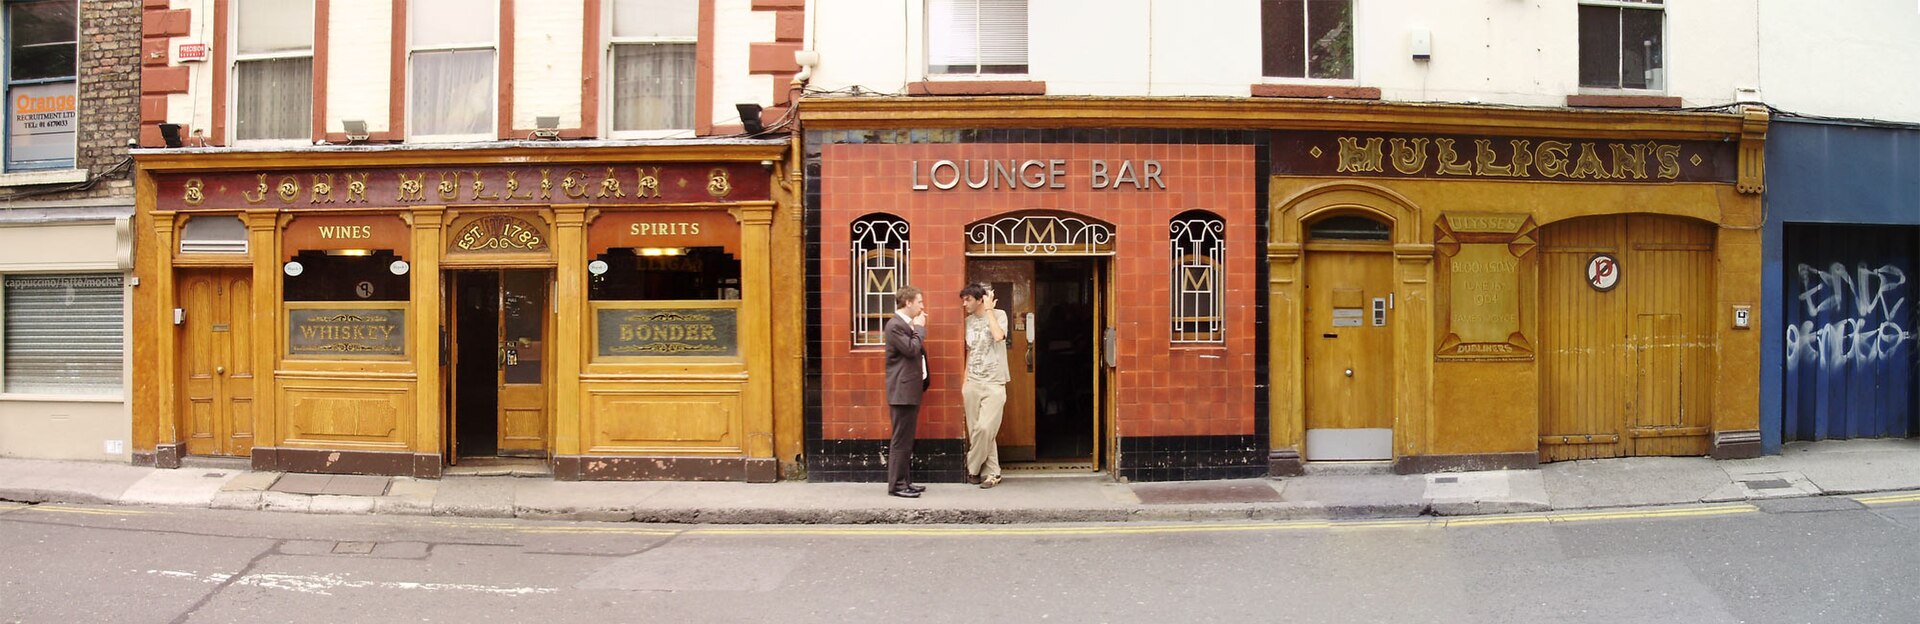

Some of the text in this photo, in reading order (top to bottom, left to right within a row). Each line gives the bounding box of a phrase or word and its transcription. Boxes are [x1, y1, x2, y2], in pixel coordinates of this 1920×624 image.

[17, 94, 75, 111] Orange
[17, 112, 61, 121] RECRUITMENT
[1336, 136, 1682, 179] MULLIGAN'S
[912, 159, 1166, 191] LOUNGE BAR
[185, 167, 731, 206] 8 JOHN MULLIGAN 8
[319, 225, 371, 239] WINES
[458, 223, 540, 250] EST. 1782
[630, 222, 700, 236] SPIRITS
[300, 325, 396, 341] WHISKEY
[619, 324, 718, 342] BONDER
[1457, 344, 1512, 354] DUBLINERS
